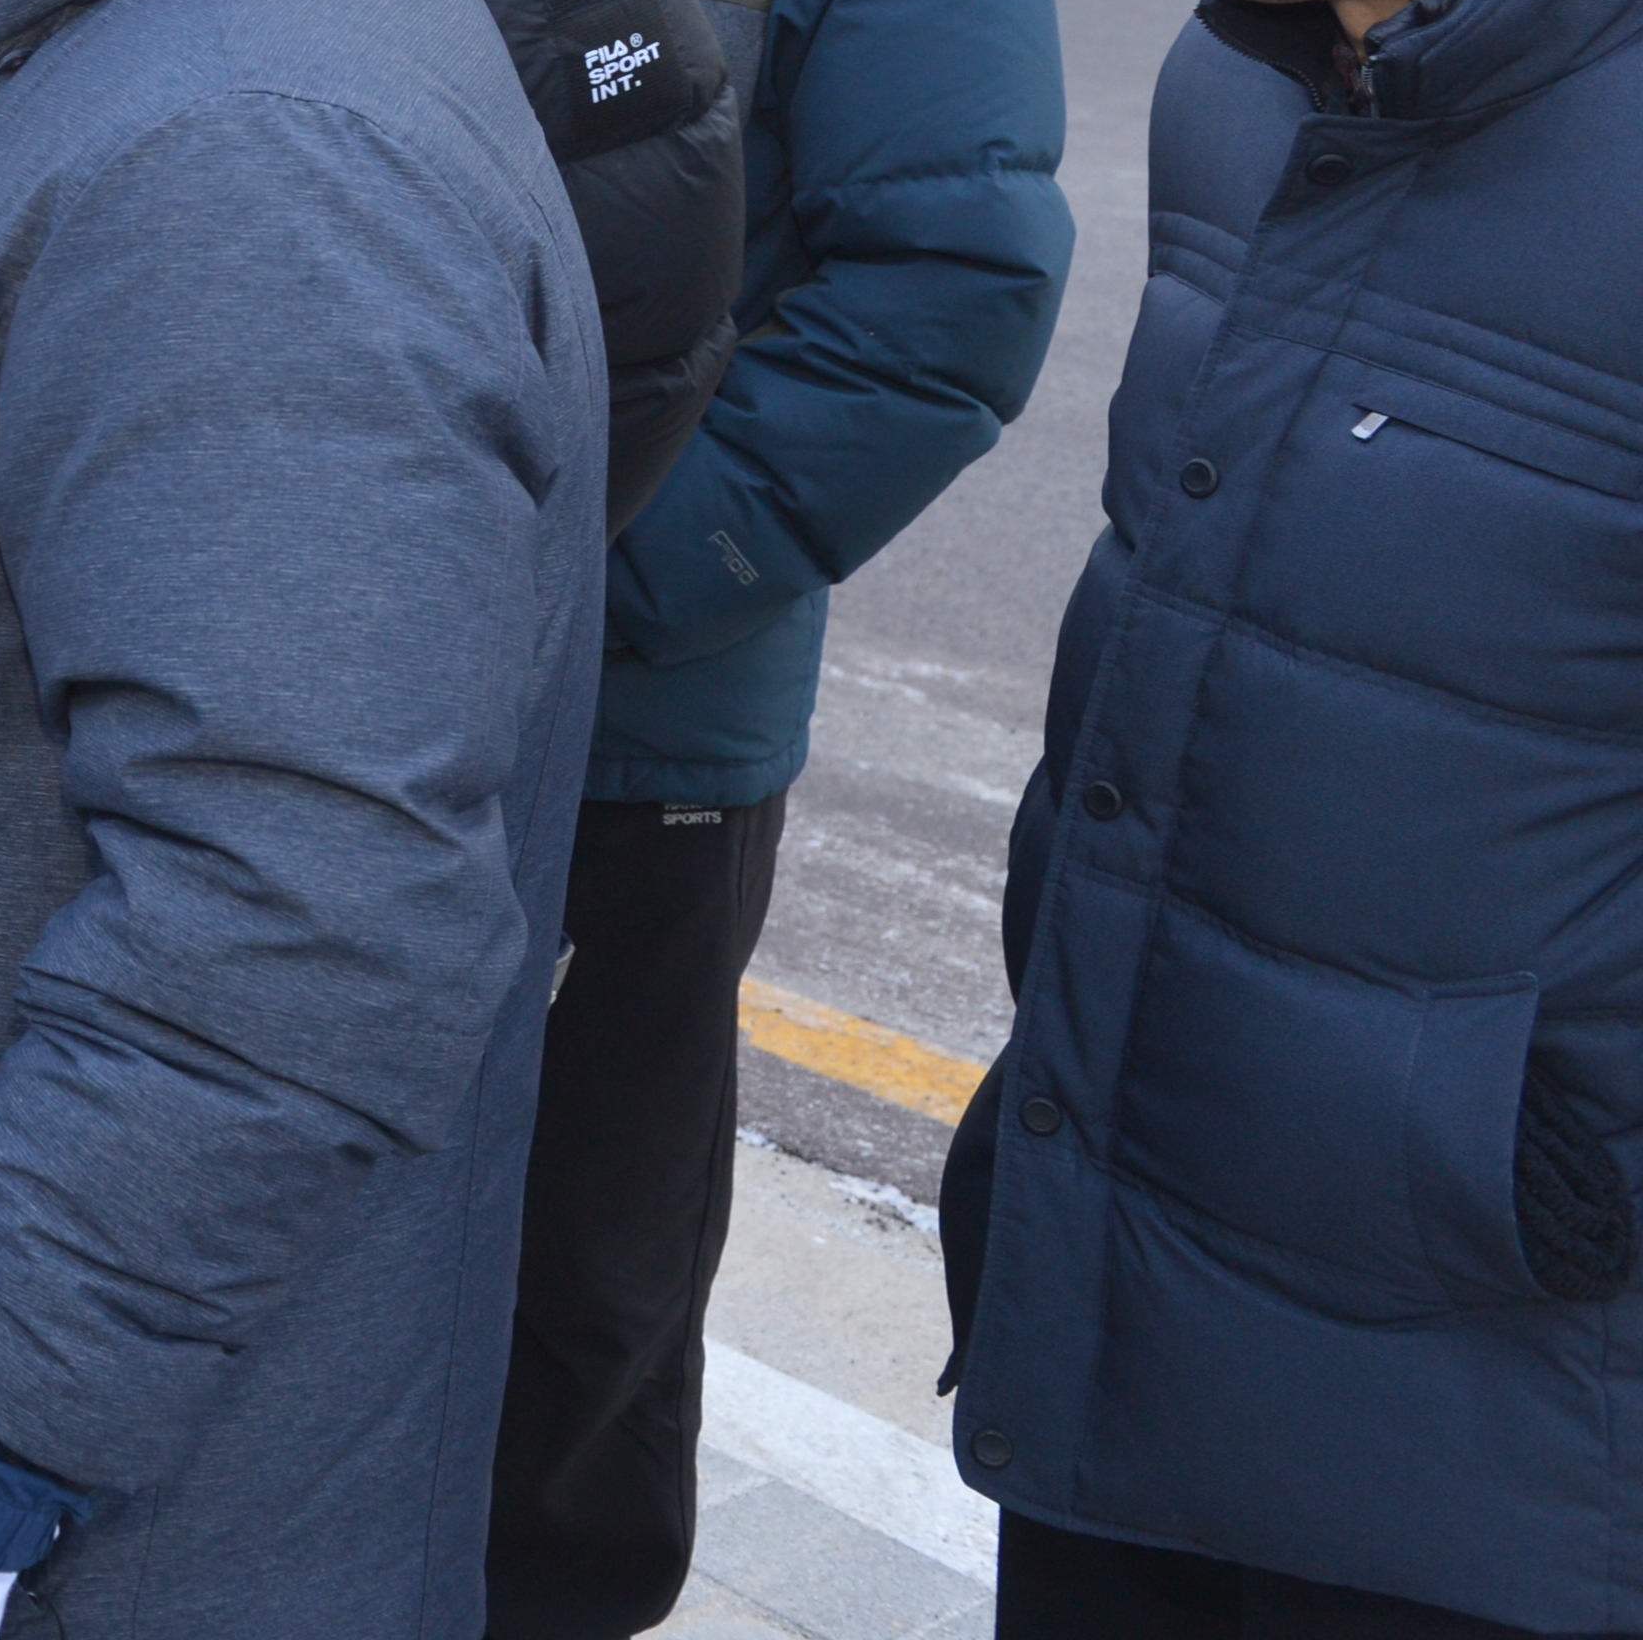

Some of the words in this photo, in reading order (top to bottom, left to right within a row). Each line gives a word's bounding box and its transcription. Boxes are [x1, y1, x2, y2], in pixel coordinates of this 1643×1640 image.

[588, 41, 660, 85] SPORT
[591, 73, 642, 104] INT.
[663, 810, 722, 826] SPORTS
